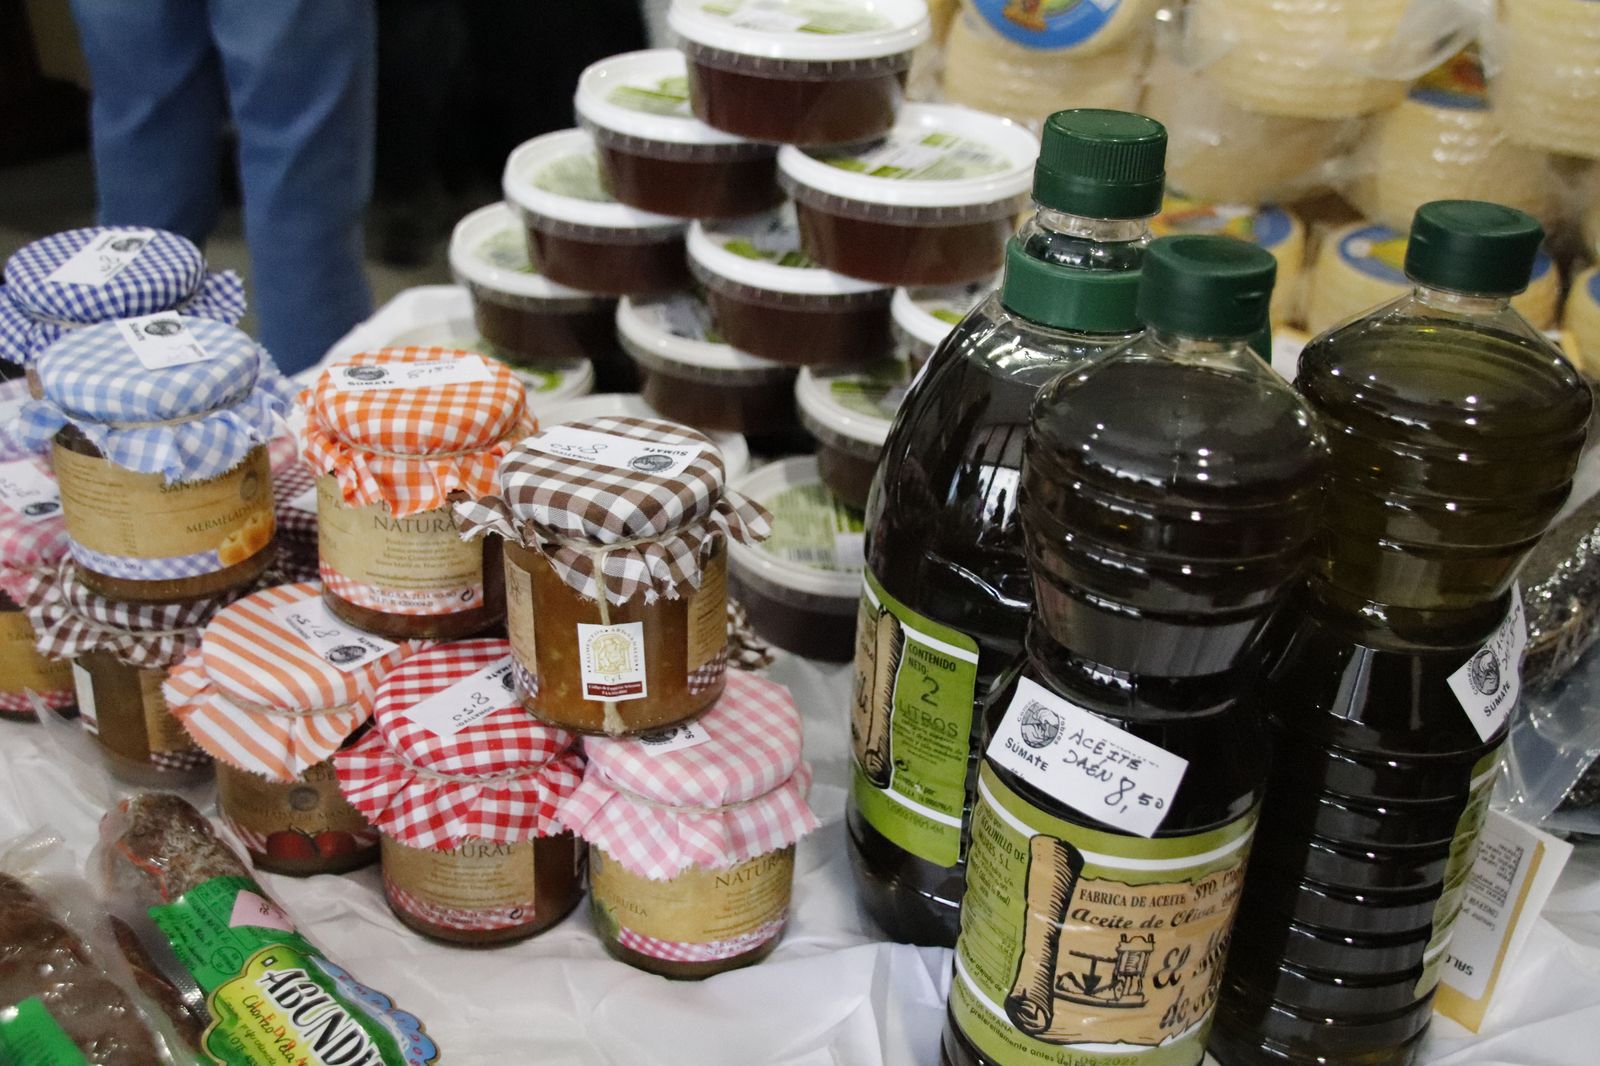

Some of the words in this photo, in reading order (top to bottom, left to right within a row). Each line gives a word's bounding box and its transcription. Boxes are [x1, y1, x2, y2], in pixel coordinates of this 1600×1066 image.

[374, 515, 458, 535] NATURA
[908, 643, 957, 673] CONTENIDO
[908, 657, 929, 676] NETO:
[485, 663, 513, 681] MATE
[921, 675, 940, 707] 2
[898, 698, 960, 739] LITROS
[1068, 728, 1145, 772] ACEITE
[431, 844, 517, 859] ATURAL
[1013, 849, 1027, 865] DE
[1079, 888, 1128, 908] FABRICA
[1131, 895, 1146, 908] DE
[1148, 893, 1186, 908] ACEITE
[1070, 908, 1134, 929] Aceite
[1139, 914, 1165, 930] de
[1170, 905, 1217, 928] Oliva
[260, 968, 387, 1066] ABUNDI
[1158, 985, 1191, 1030] de
